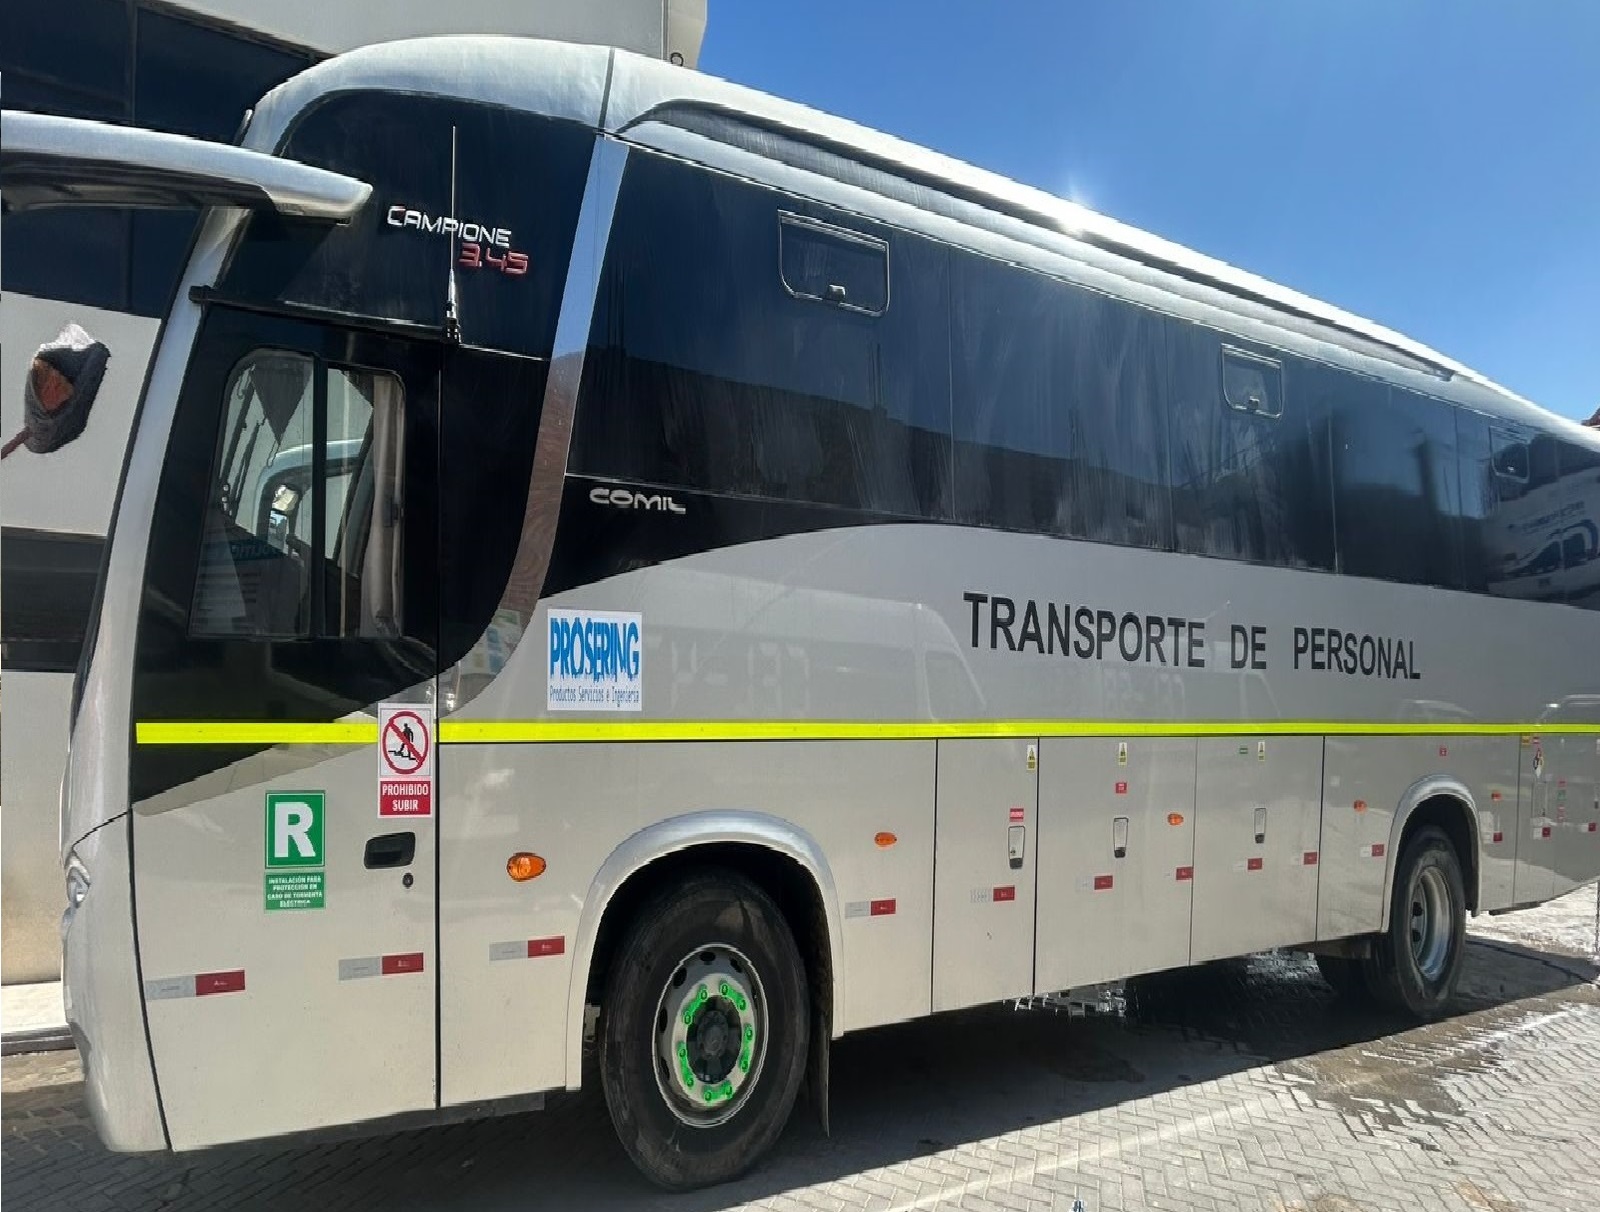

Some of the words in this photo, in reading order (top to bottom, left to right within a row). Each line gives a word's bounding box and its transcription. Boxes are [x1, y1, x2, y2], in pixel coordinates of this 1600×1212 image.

[387, 205, 511, 248] CAMPIONE
[459, 242, 529, 274] 3.45
[589, 487, 686, 514] COMIL
[550, 617, 639, 681] PROSERING
[963, 591, 1205, 667] TRANSPORTE
[1231, 624, 1266, 669] DE
[1294, 627, 1420, 679] PERSONAL
[550, 685, 576, 702] Productos
[579, 686, 604, 702] Servicios
[382, 784, 428, 796] PROHIBIDO
[392, 800, 418, 811] SUBIR
[274, 802, 316, 857] R
